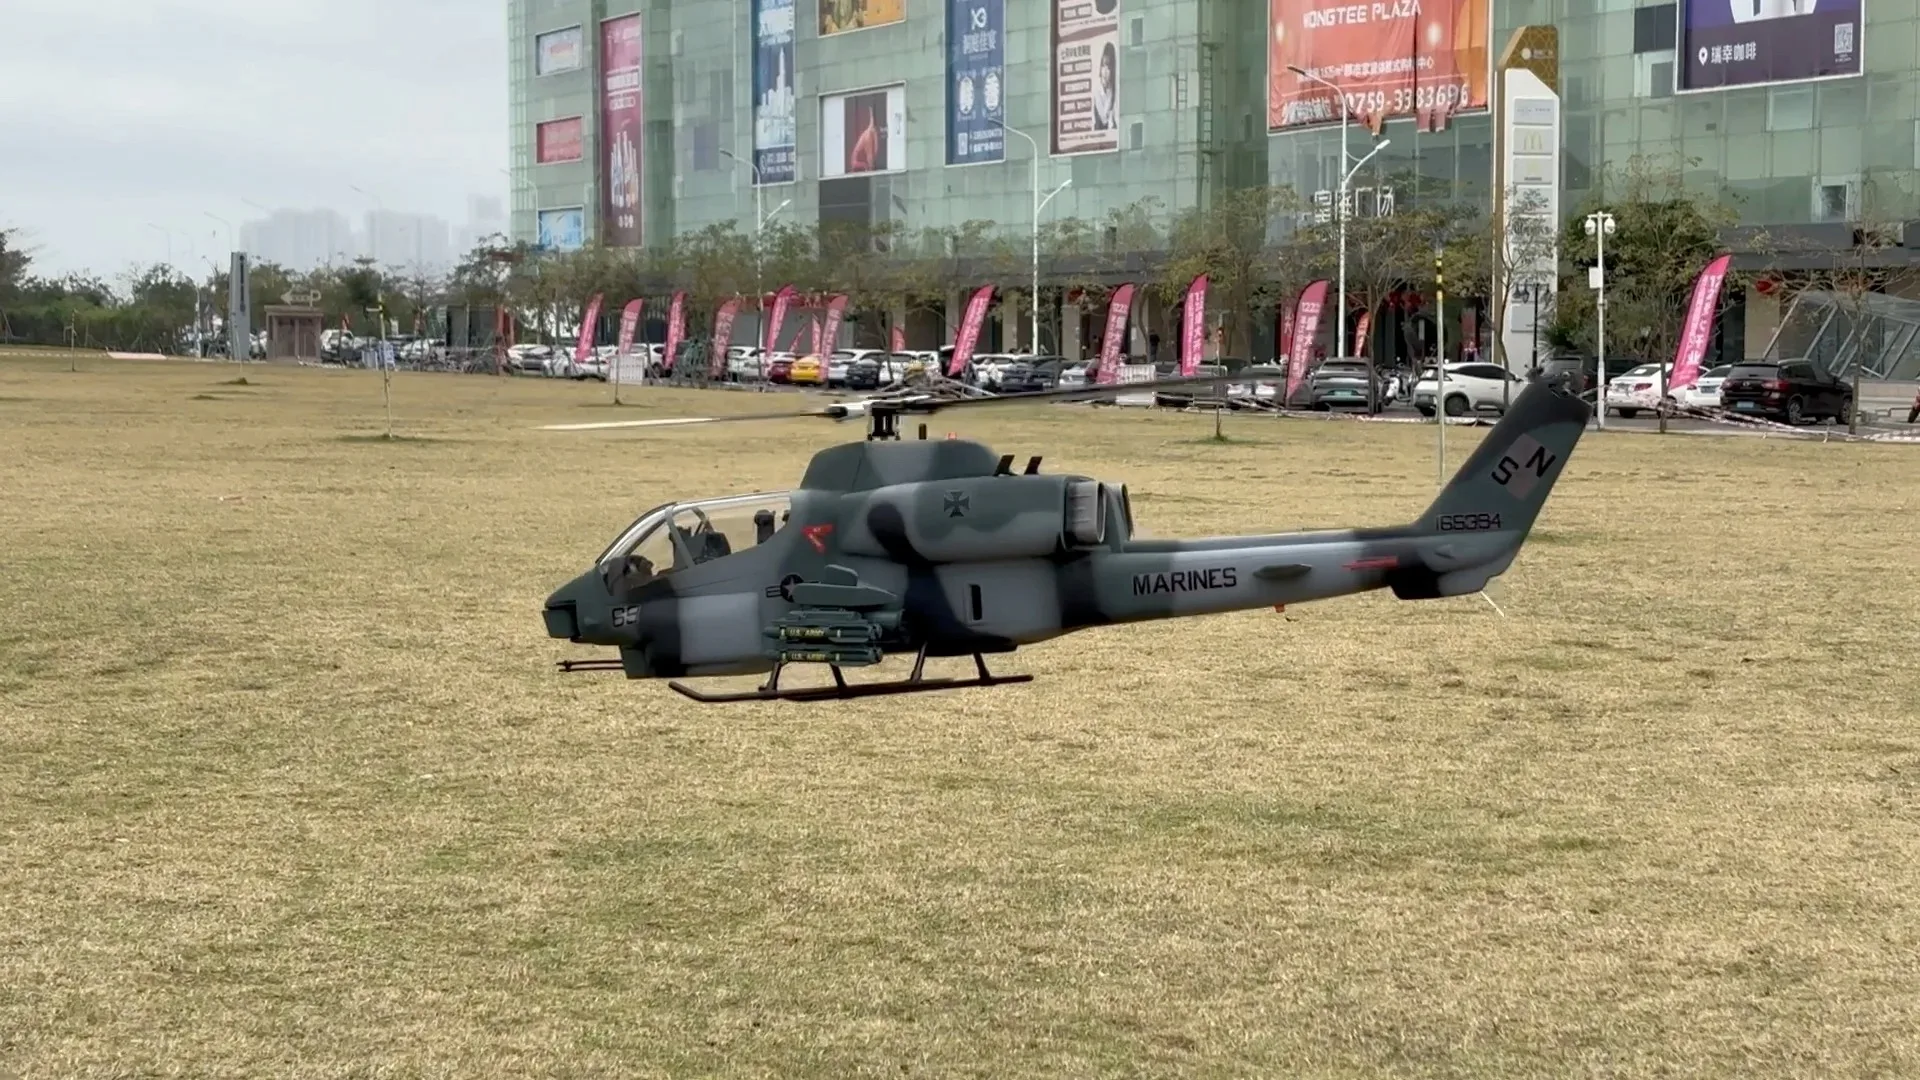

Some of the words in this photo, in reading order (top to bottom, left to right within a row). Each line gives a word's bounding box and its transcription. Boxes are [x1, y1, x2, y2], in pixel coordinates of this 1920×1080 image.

[1372, 0, 1421, 21] PLAZA
[1711, 42, 1756, 64] 瑞幸咖啡
[1132, 567, 1237, 596] MARINES
